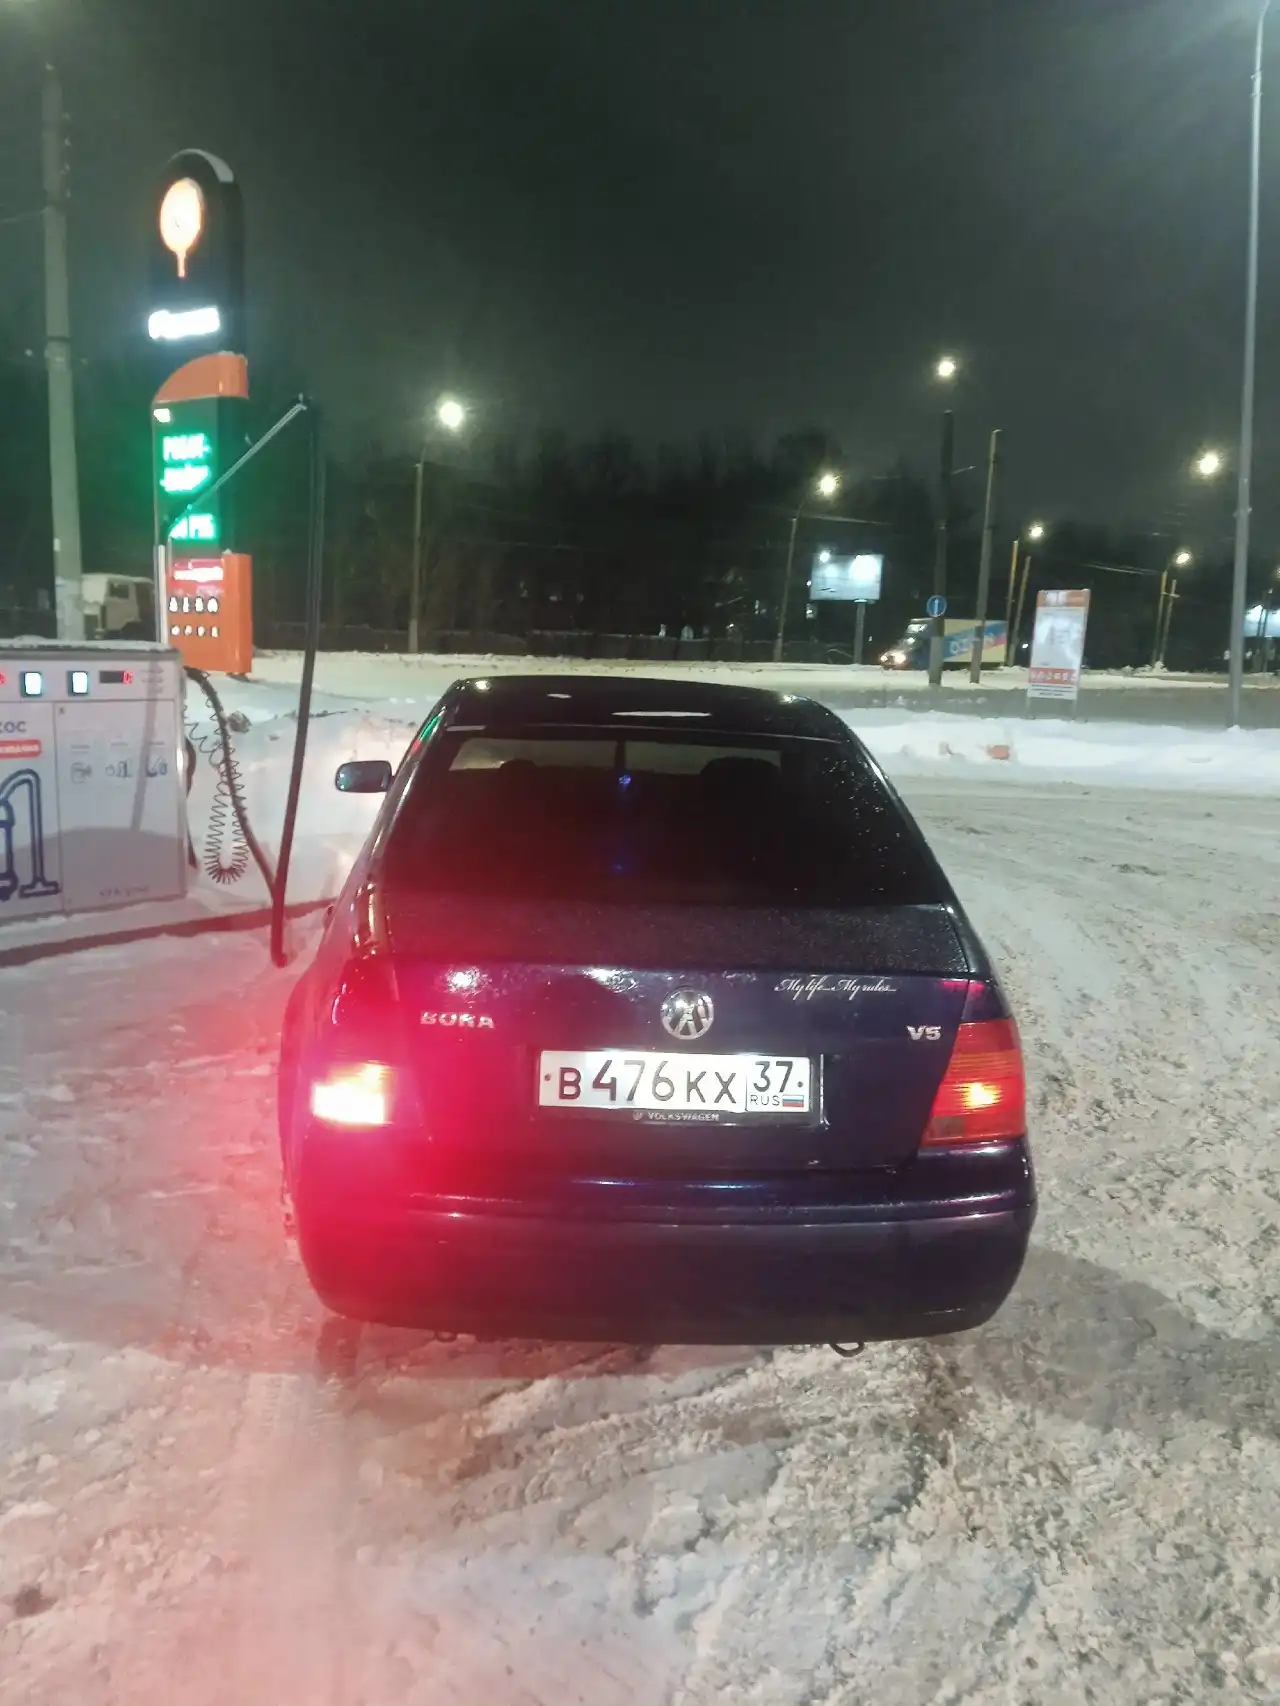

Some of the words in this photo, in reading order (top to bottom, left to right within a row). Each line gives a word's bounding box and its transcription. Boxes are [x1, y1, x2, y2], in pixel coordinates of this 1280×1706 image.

[420, 1011, 495, 1029] BORA
[907, 1025, 942, 1041] V5
[753, 1060, 793, 1093] 37
[750, 1094, 780, 1106] RUS
[647, 1111, 720, 1121] VOLKSWAGEN
